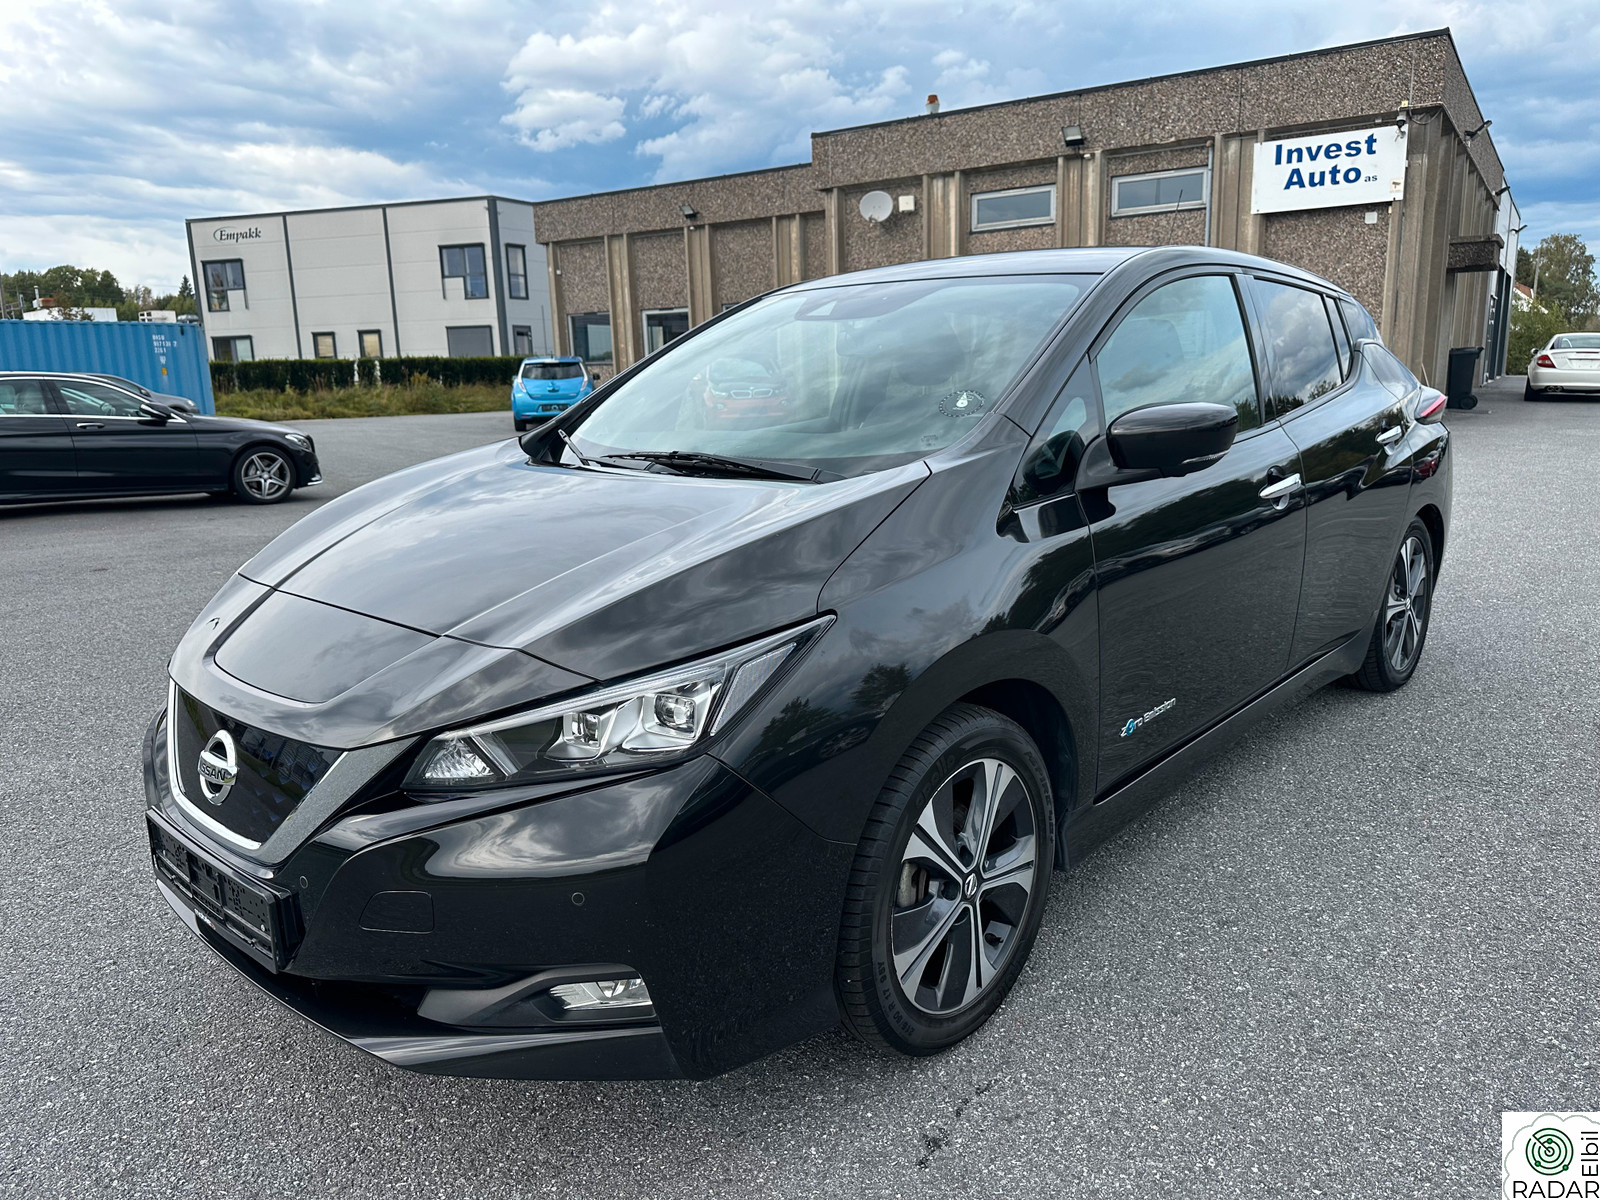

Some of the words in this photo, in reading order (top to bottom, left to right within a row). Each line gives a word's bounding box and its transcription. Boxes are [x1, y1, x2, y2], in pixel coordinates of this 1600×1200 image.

[1275, 133, 1377, 165] Invest
[1283, 164, 1362, 190] Auto
[1364, 174, 1378, 182] as
[219, 227, 262, 243] Empakk
[200, 762, 226, 782] SSAN
